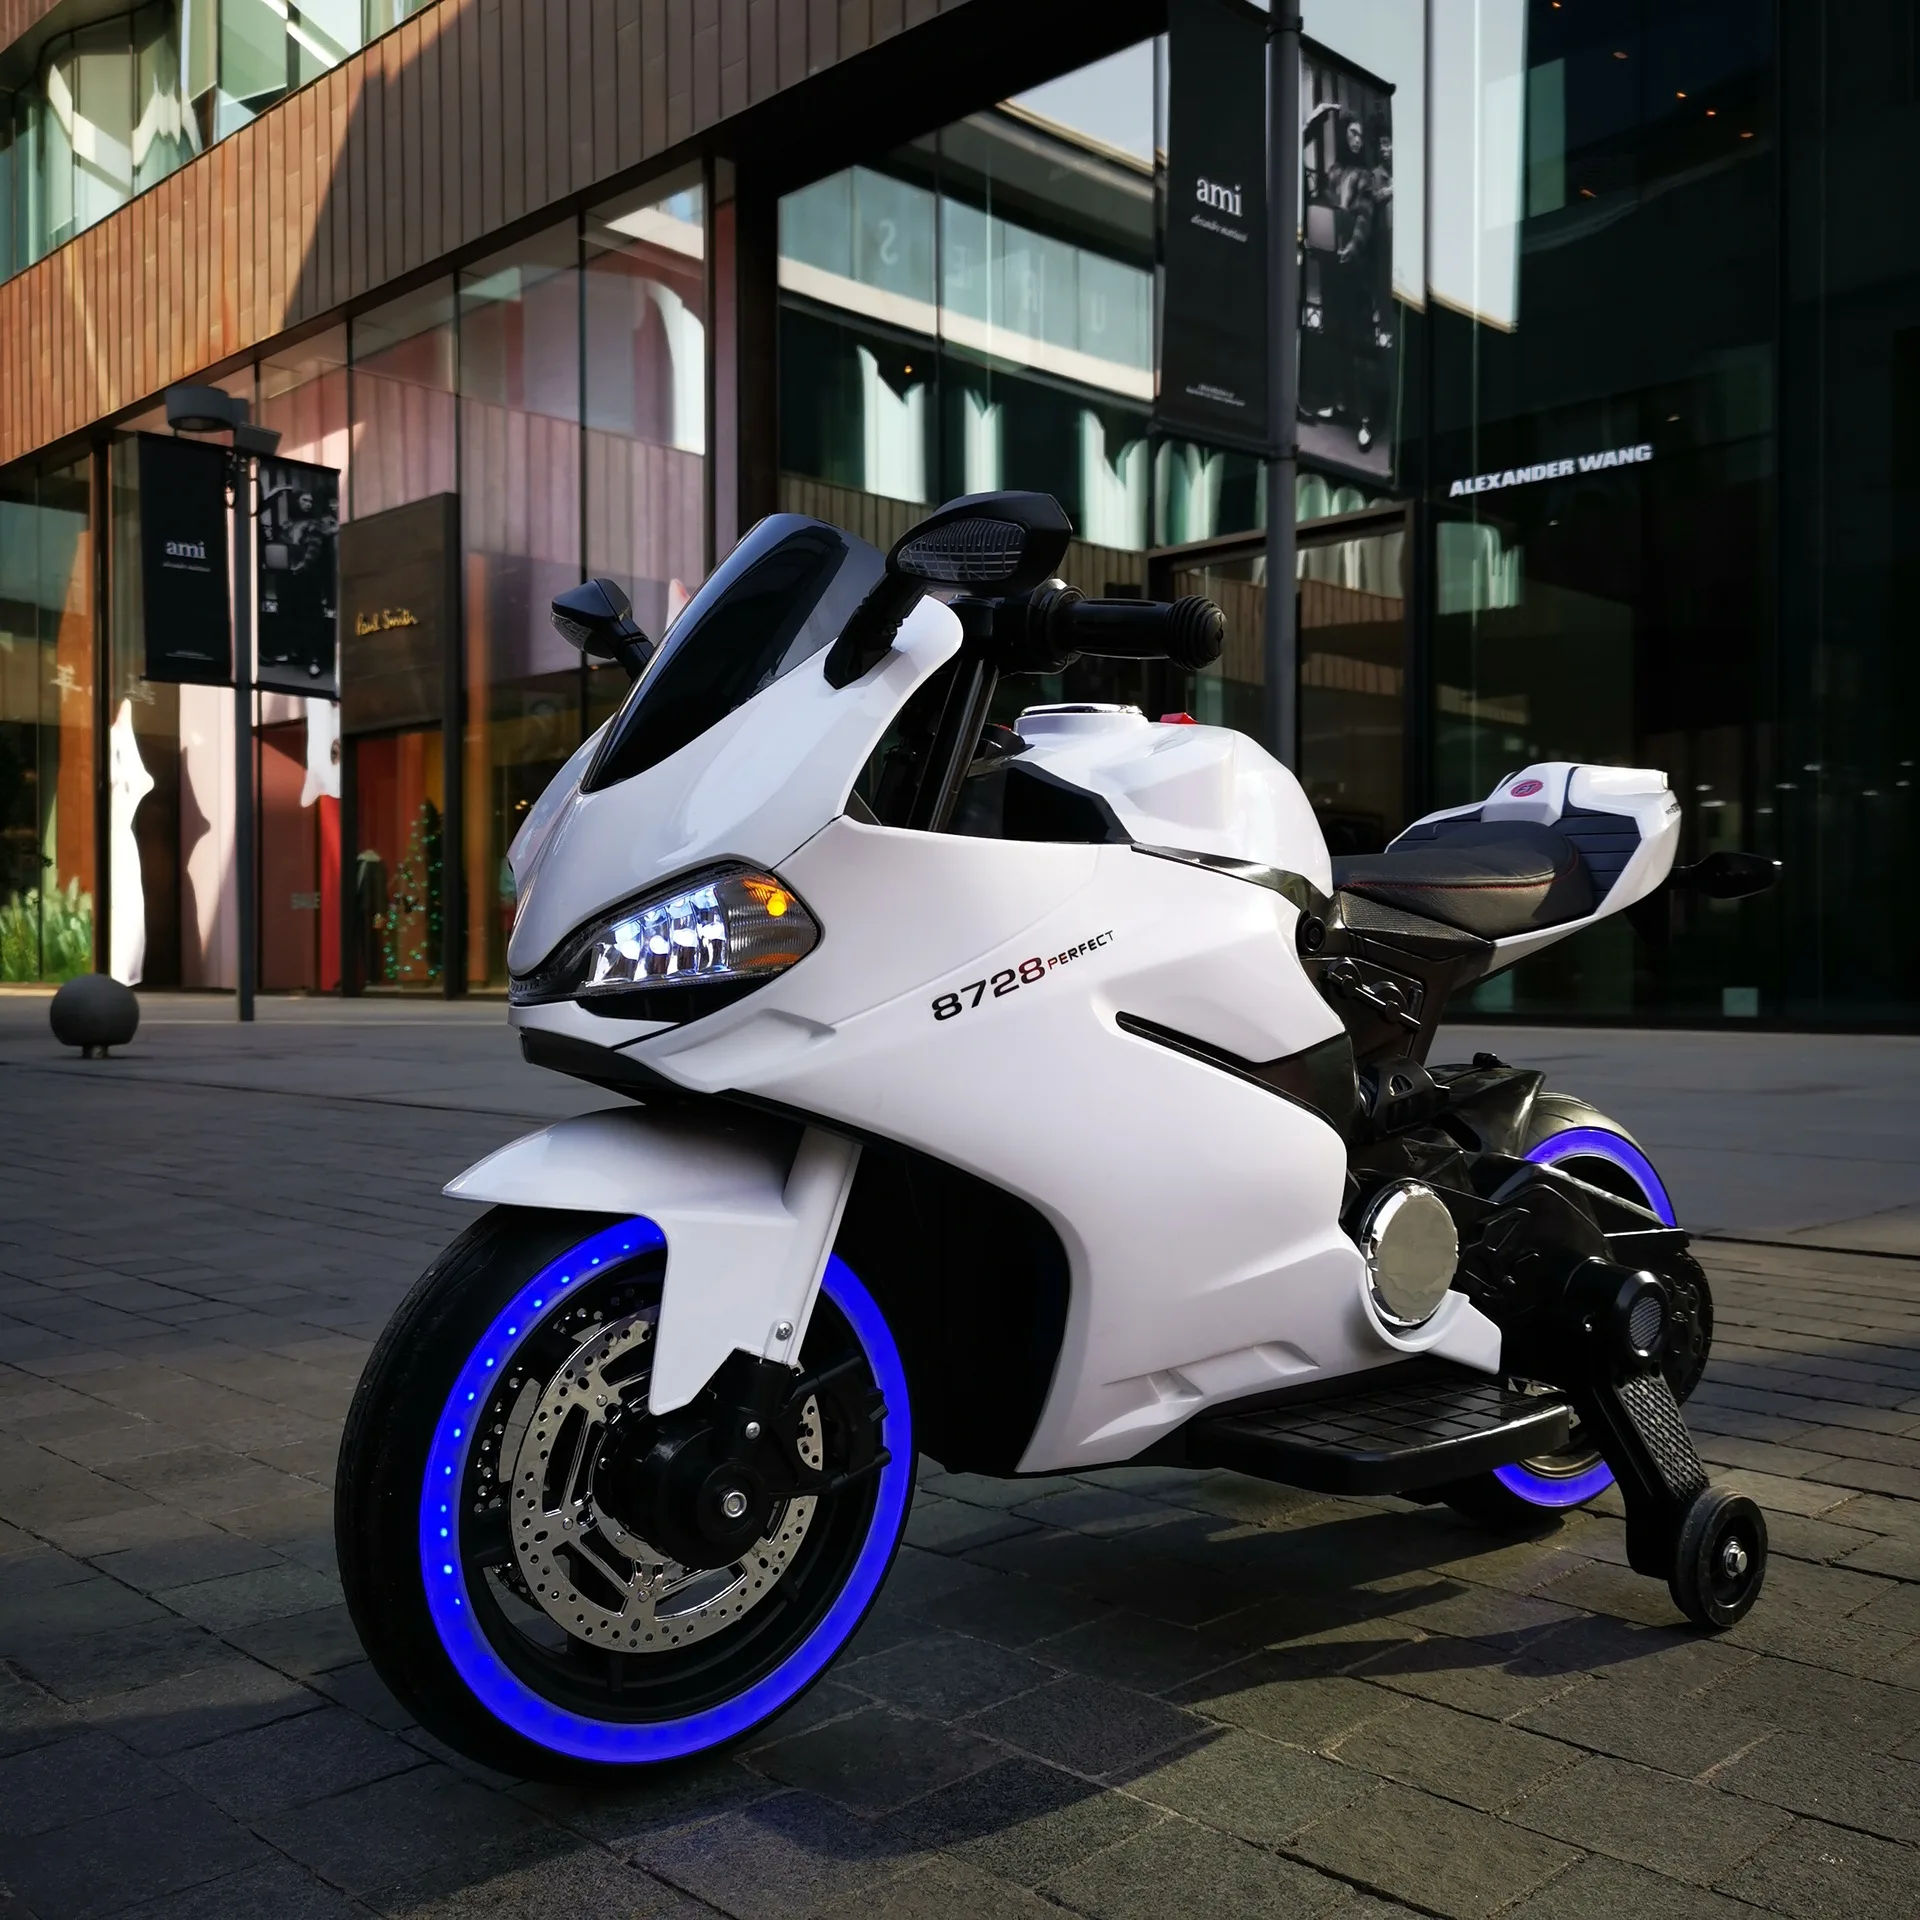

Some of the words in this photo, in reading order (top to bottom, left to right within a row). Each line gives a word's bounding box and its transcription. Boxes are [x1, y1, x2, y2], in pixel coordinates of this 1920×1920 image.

[1196, 178, 1243, 217] ami
[1450, 459, 1576, 497] ALEXANDER
[1578, 443, 1653, 472] WANG
[166, 540, 206, 559] ami
[931, 957, 1046, 1021] 8728
[1047, 930, 1114, 969] PERFECT
